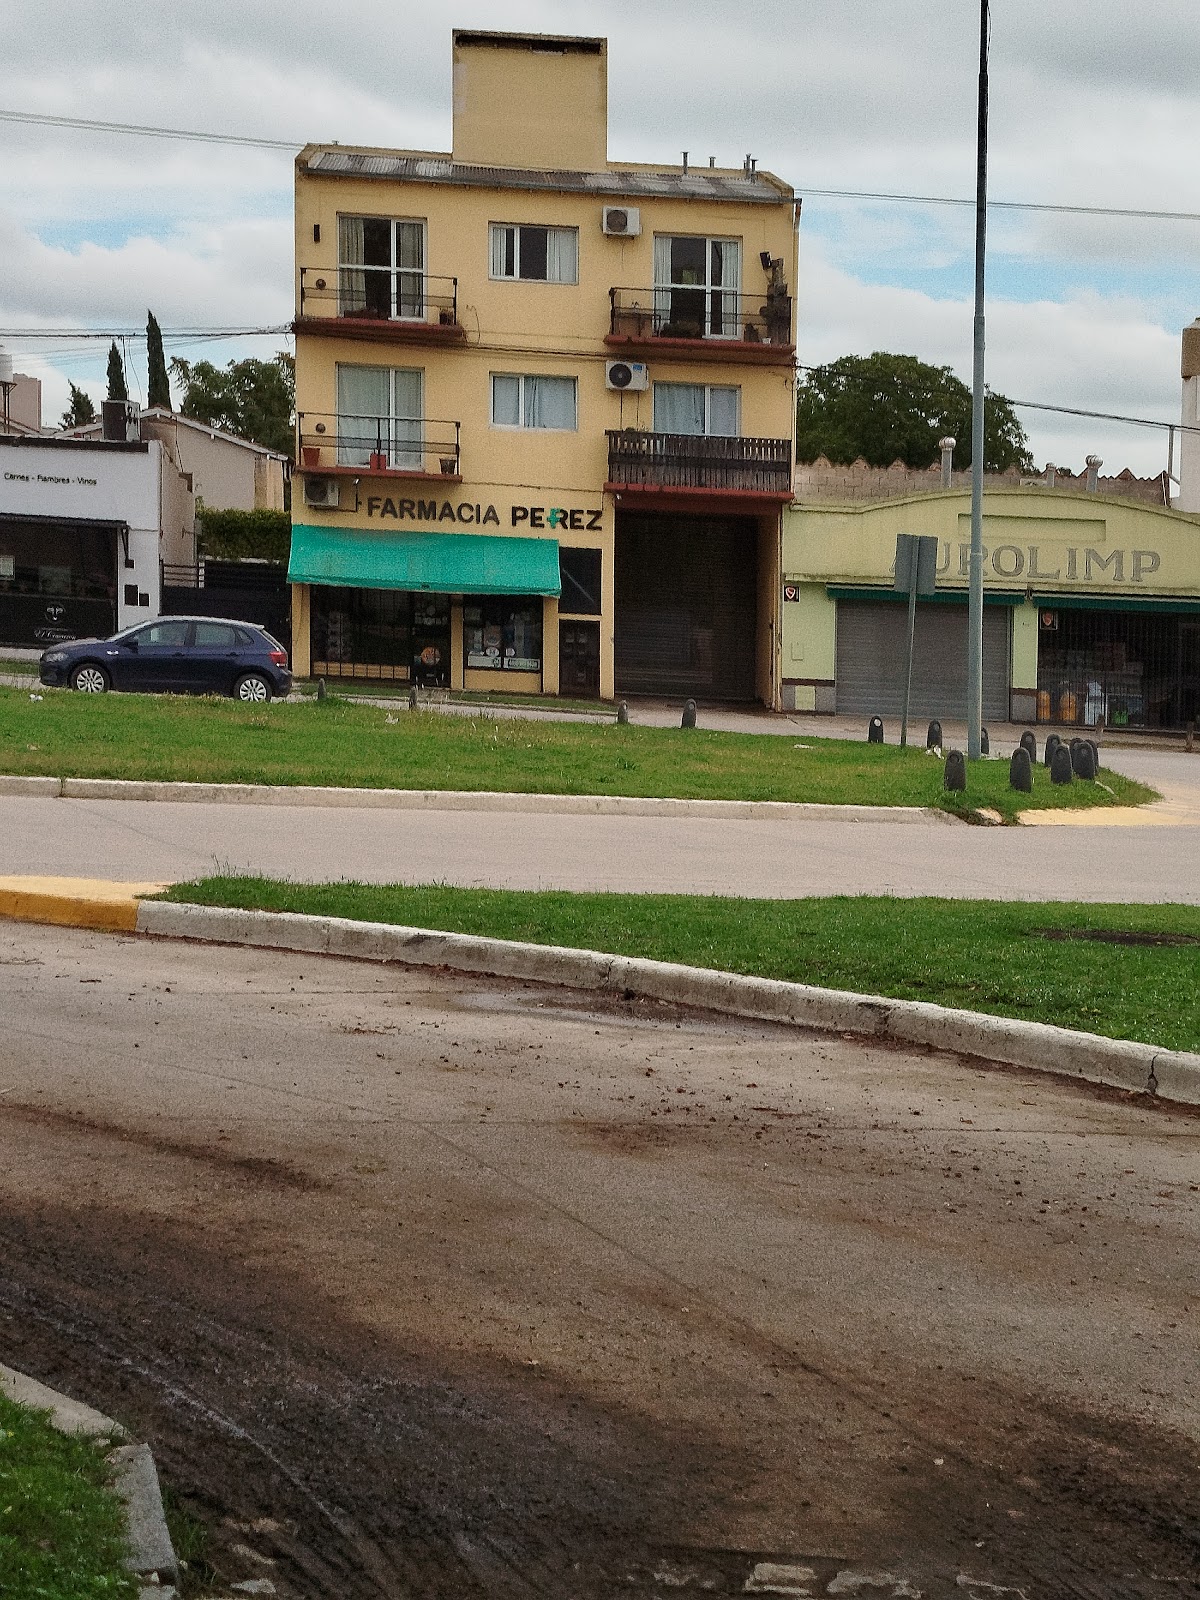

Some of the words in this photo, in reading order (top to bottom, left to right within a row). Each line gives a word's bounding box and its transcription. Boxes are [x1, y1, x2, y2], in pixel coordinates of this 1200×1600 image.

[77, 476, 97, 486] Vinos
[367, 497, 500, 526] FARMACIA
[511, 506, 602, 531] PEREZ
[889, 541, 1161, 582] UROLIMP
